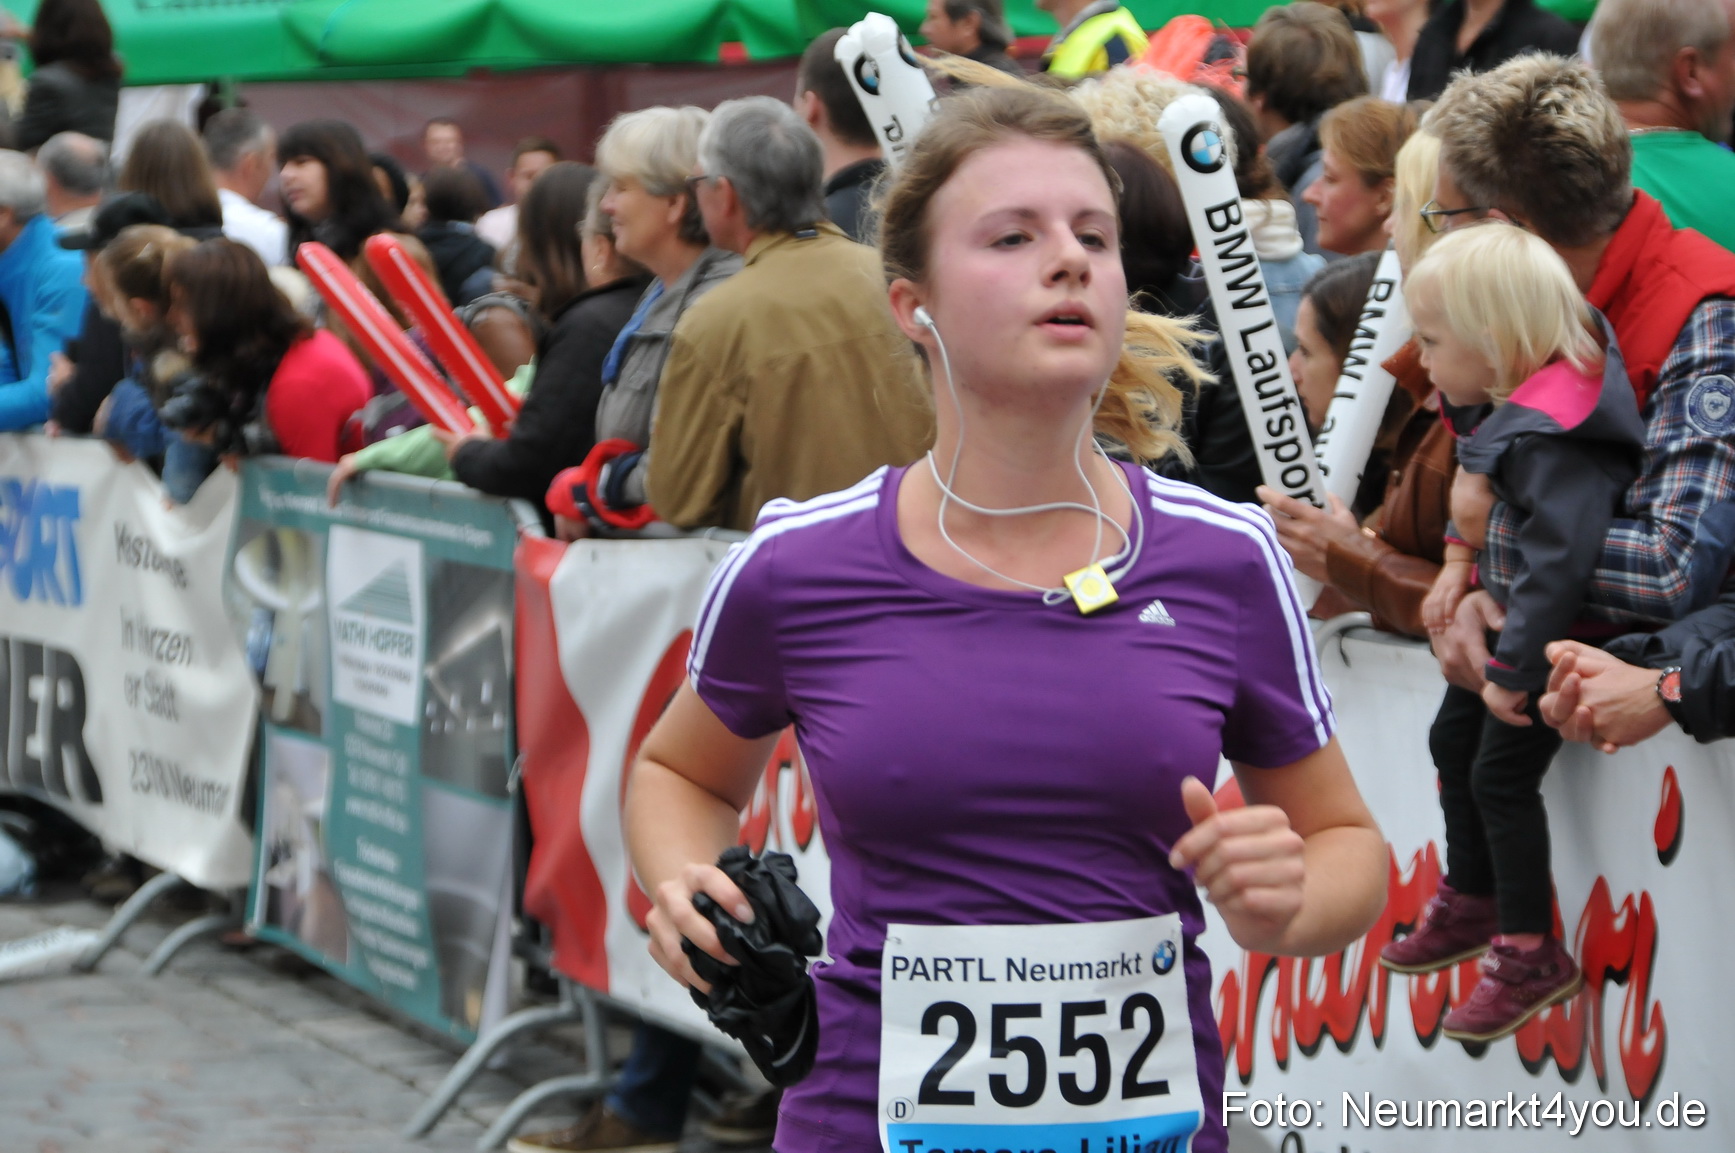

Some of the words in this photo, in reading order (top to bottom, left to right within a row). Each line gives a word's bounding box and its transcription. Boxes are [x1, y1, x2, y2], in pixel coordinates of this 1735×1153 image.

[1203, 196, 1269, 310] BMW
[1239, 318, 1325, 509] Laufspor
[891, 955, 996, 983] PARTL
[1006, 952, 1143, 983] Neumarkt
[917, 991, 1171, 1108] 2552
[894, 1101, 907, 1119] D
